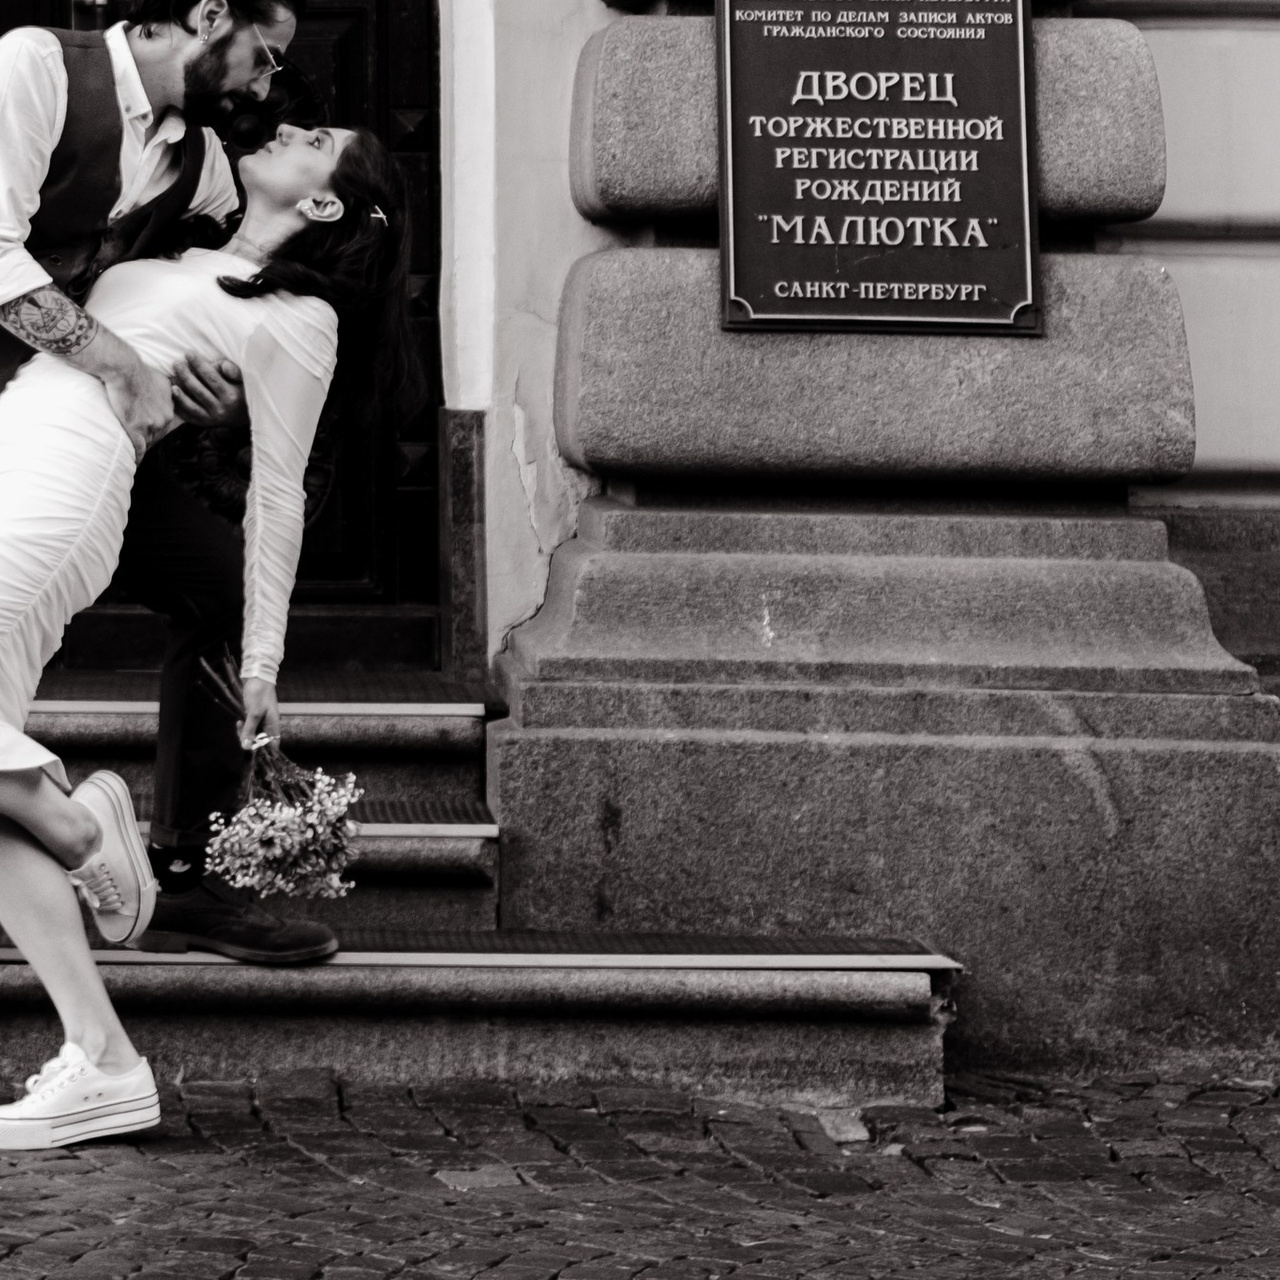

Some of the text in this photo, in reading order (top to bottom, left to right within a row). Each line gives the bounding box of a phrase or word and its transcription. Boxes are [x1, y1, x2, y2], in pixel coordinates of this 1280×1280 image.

[735, 11, 1013, 25] КОМИТЕТ ПО ДЕЛАМ ЗАПИСИ АКТОВ
[764, 26, 985, 39] ГРАЖДАНСКОГО СОСТОЯНИЯ
[791, 71, 957, 106] ДВОРЕЦ
[749, 115, 1004, 141] ТОРЖЕСТВЕННОЙ
[775, 147, 979, 174] РЕГИСТРАЦИИ
[796, 178, 961, 205] РОЖДЕНИЙ
[774, 281, 987, 301] САНКТ-ПЕТЕРБУРГ
